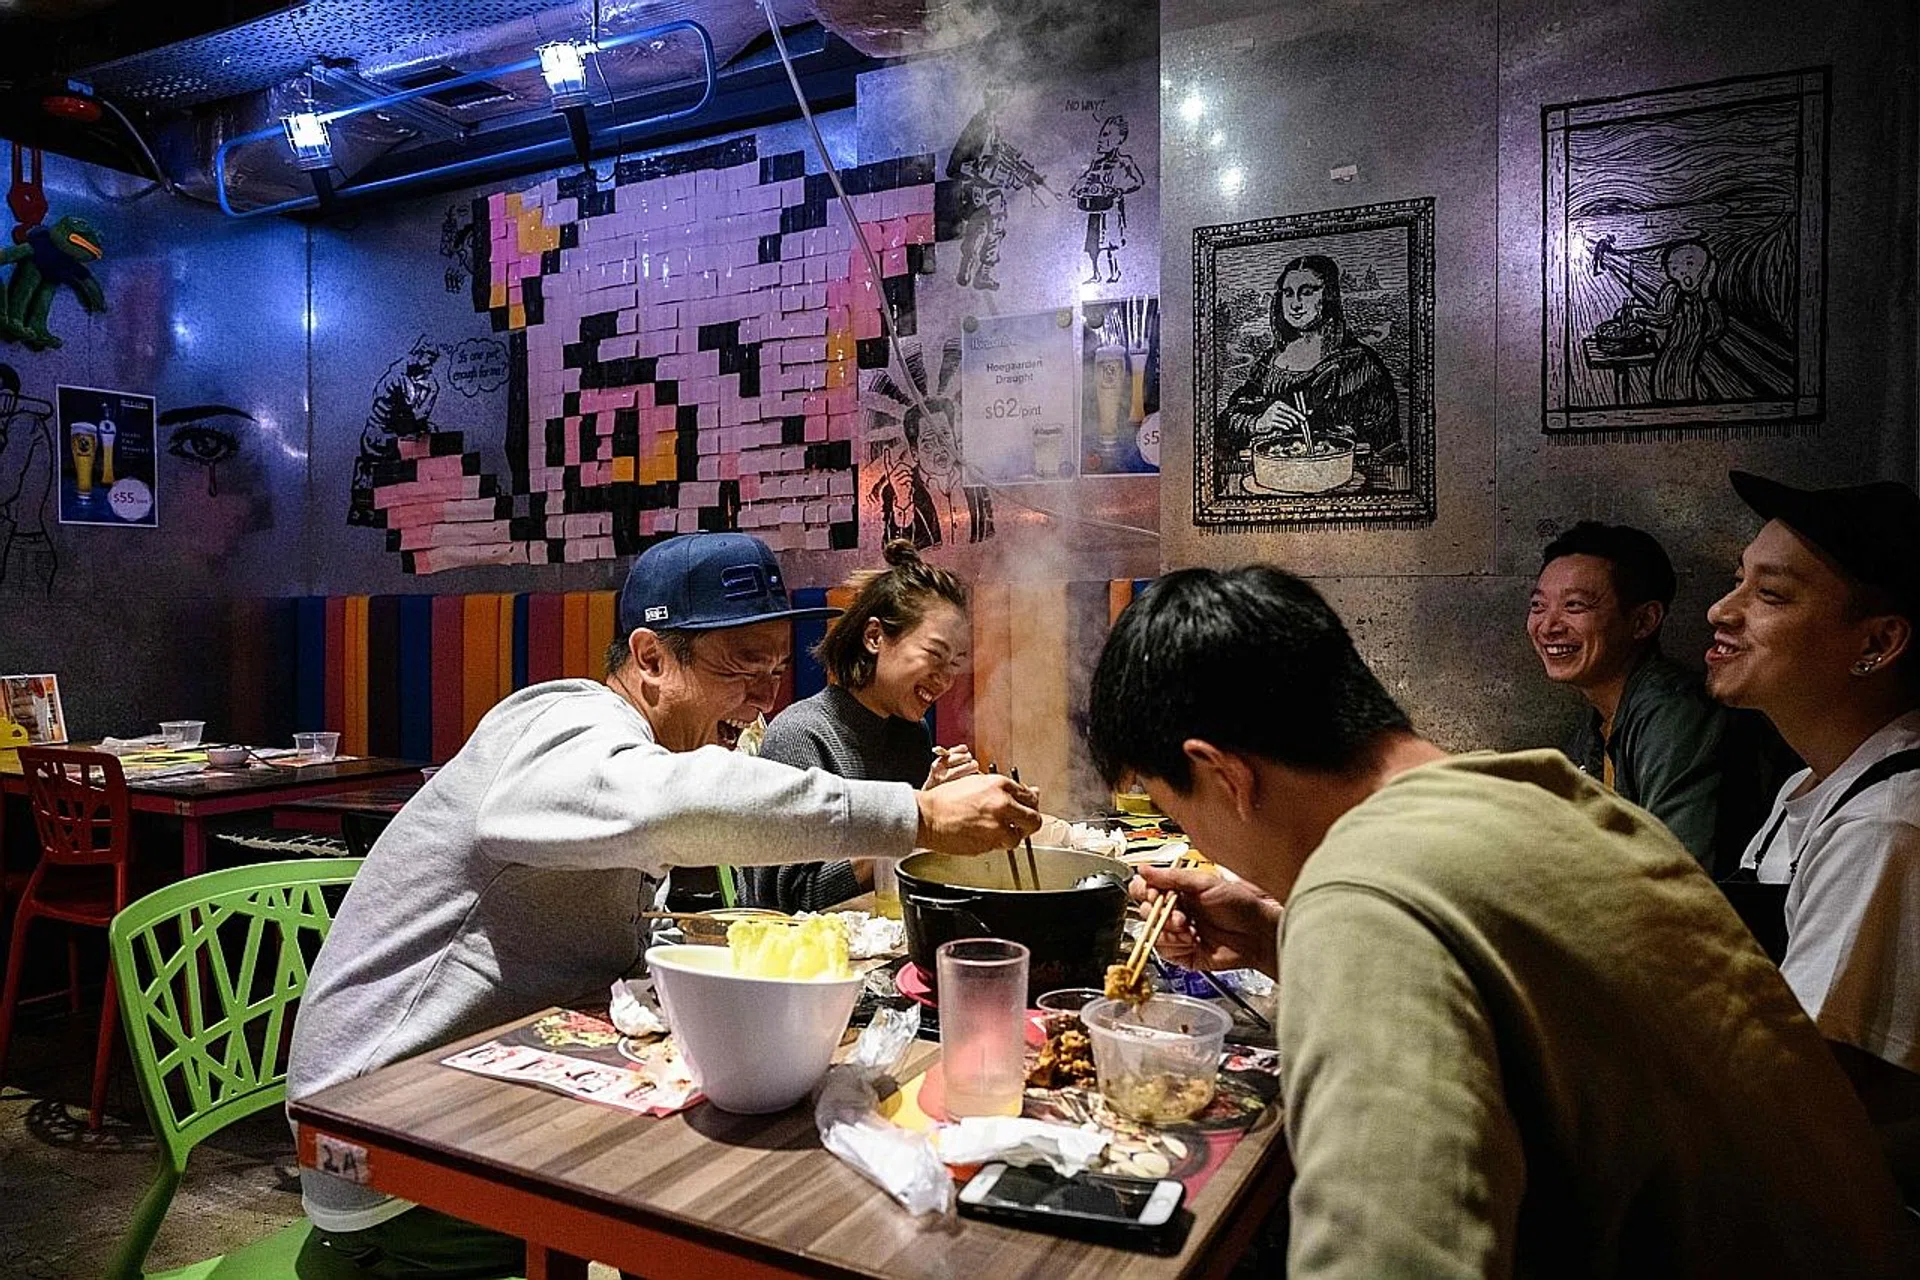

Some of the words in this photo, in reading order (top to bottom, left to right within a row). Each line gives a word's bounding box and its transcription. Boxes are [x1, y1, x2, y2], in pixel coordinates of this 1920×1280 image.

[1065, 99, 1080, 111] NO
[996, 373, 1034, 385] Draught
[323, 1144, 360, 1181] 2A
